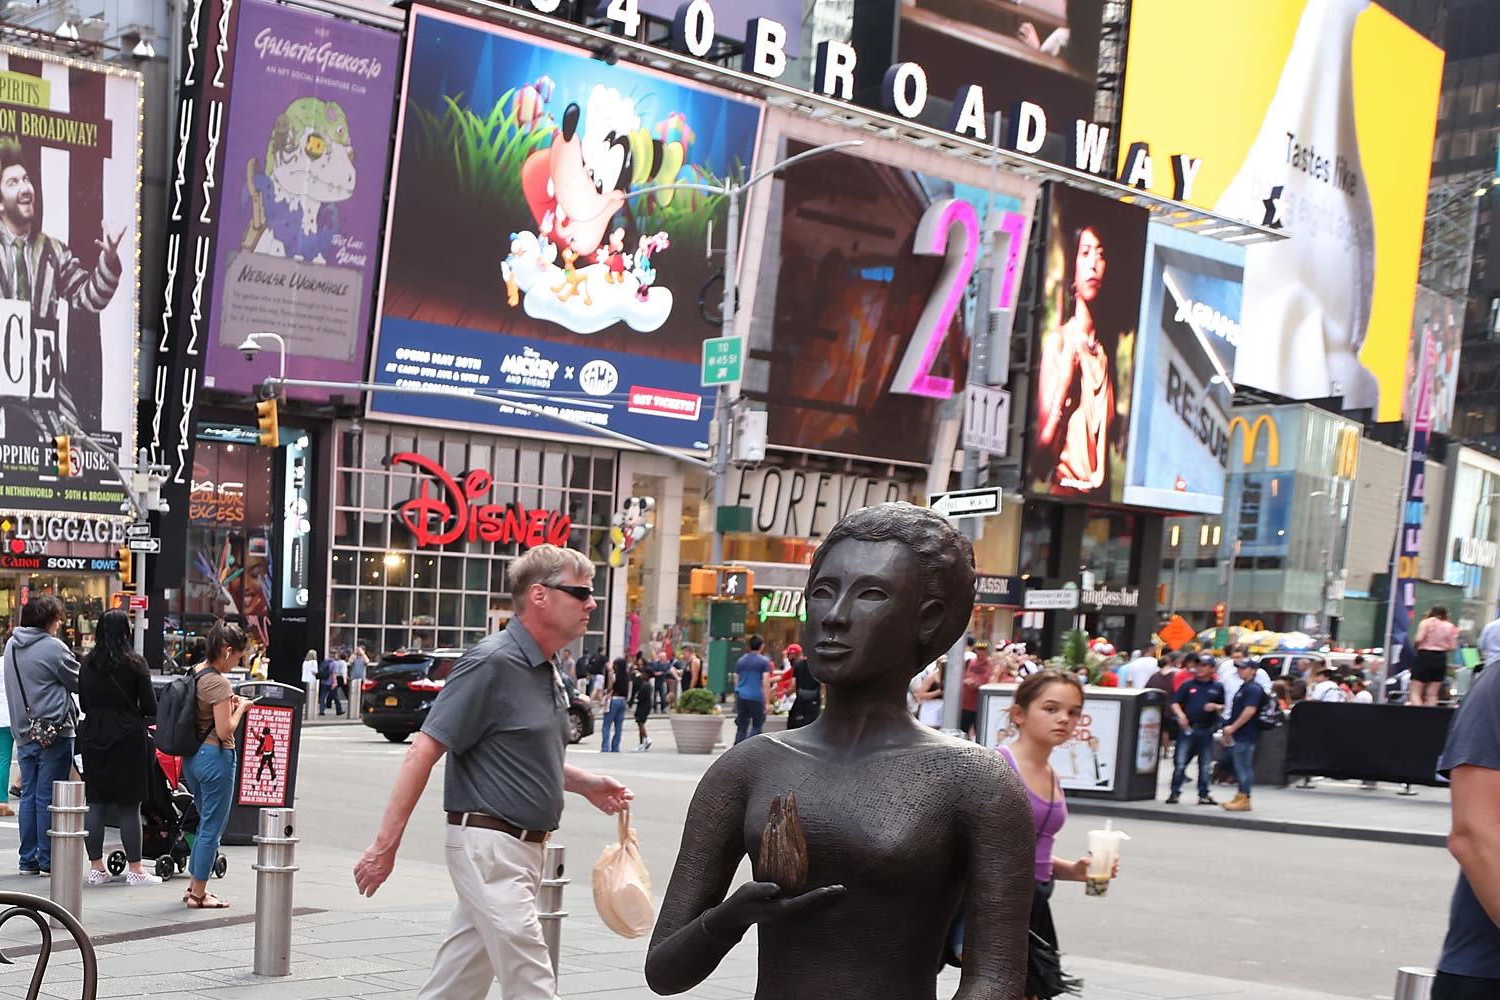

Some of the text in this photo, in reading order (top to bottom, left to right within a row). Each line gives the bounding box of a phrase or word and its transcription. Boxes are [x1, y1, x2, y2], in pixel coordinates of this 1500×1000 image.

[528, 0, 1202, 201] 40 BROADWAY
[0, 108, 98, 147] ON BROADWAY!
[1287, 131, 1357, 196] Tastes like
[237, 264, 350, 296] NEBULAR WORMHOLE
[718, 342, 730, 353] TO
[500, 355, 560, 380] MICKEY
[5, 485, 54, 498] NETHERWORLD
[88, 490, 125, 502] BROADWAY
[189, 504, 244, 521] EXCESS
[16, 517, 126, 544] LUGGAGE
[24, 540, 49, 555] NY
[1, 555, 41, 569] Canon
[47, 557, 87, 569] SONY
[978, 577, 1010, 595] ASSN.
[241, 790, 283, 798] THRILLER
